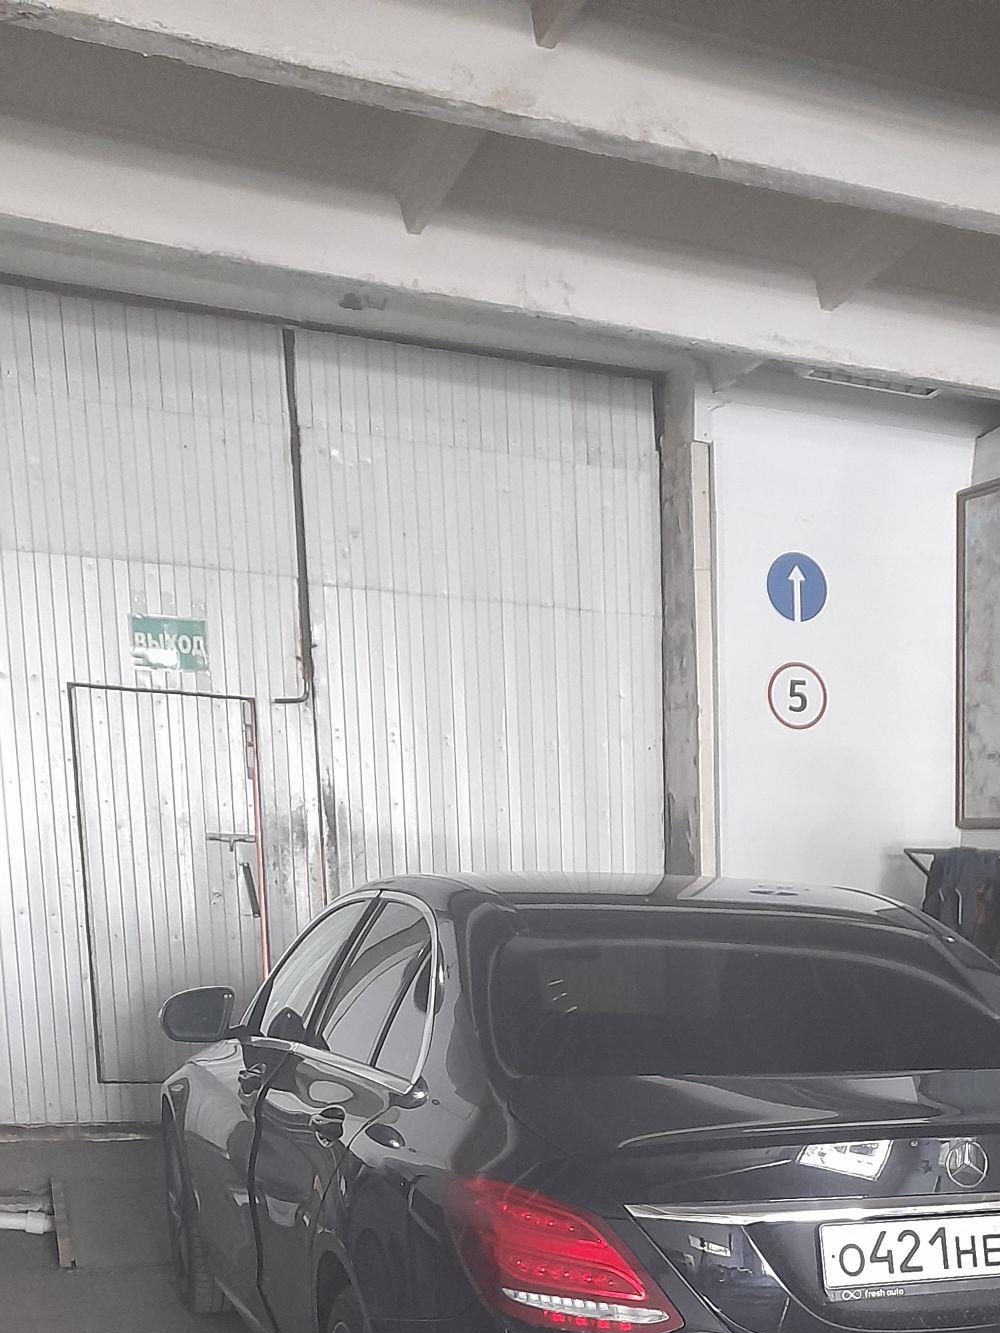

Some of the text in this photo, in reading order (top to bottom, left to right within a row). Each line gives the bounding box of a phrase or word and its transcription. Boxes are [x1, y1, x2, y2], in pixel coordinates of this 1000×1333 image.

[134, 631, 207, 659] ВЫХОД
[788, 679, 808, 713] 5
[864, 1288, 886, 1299] fresh
